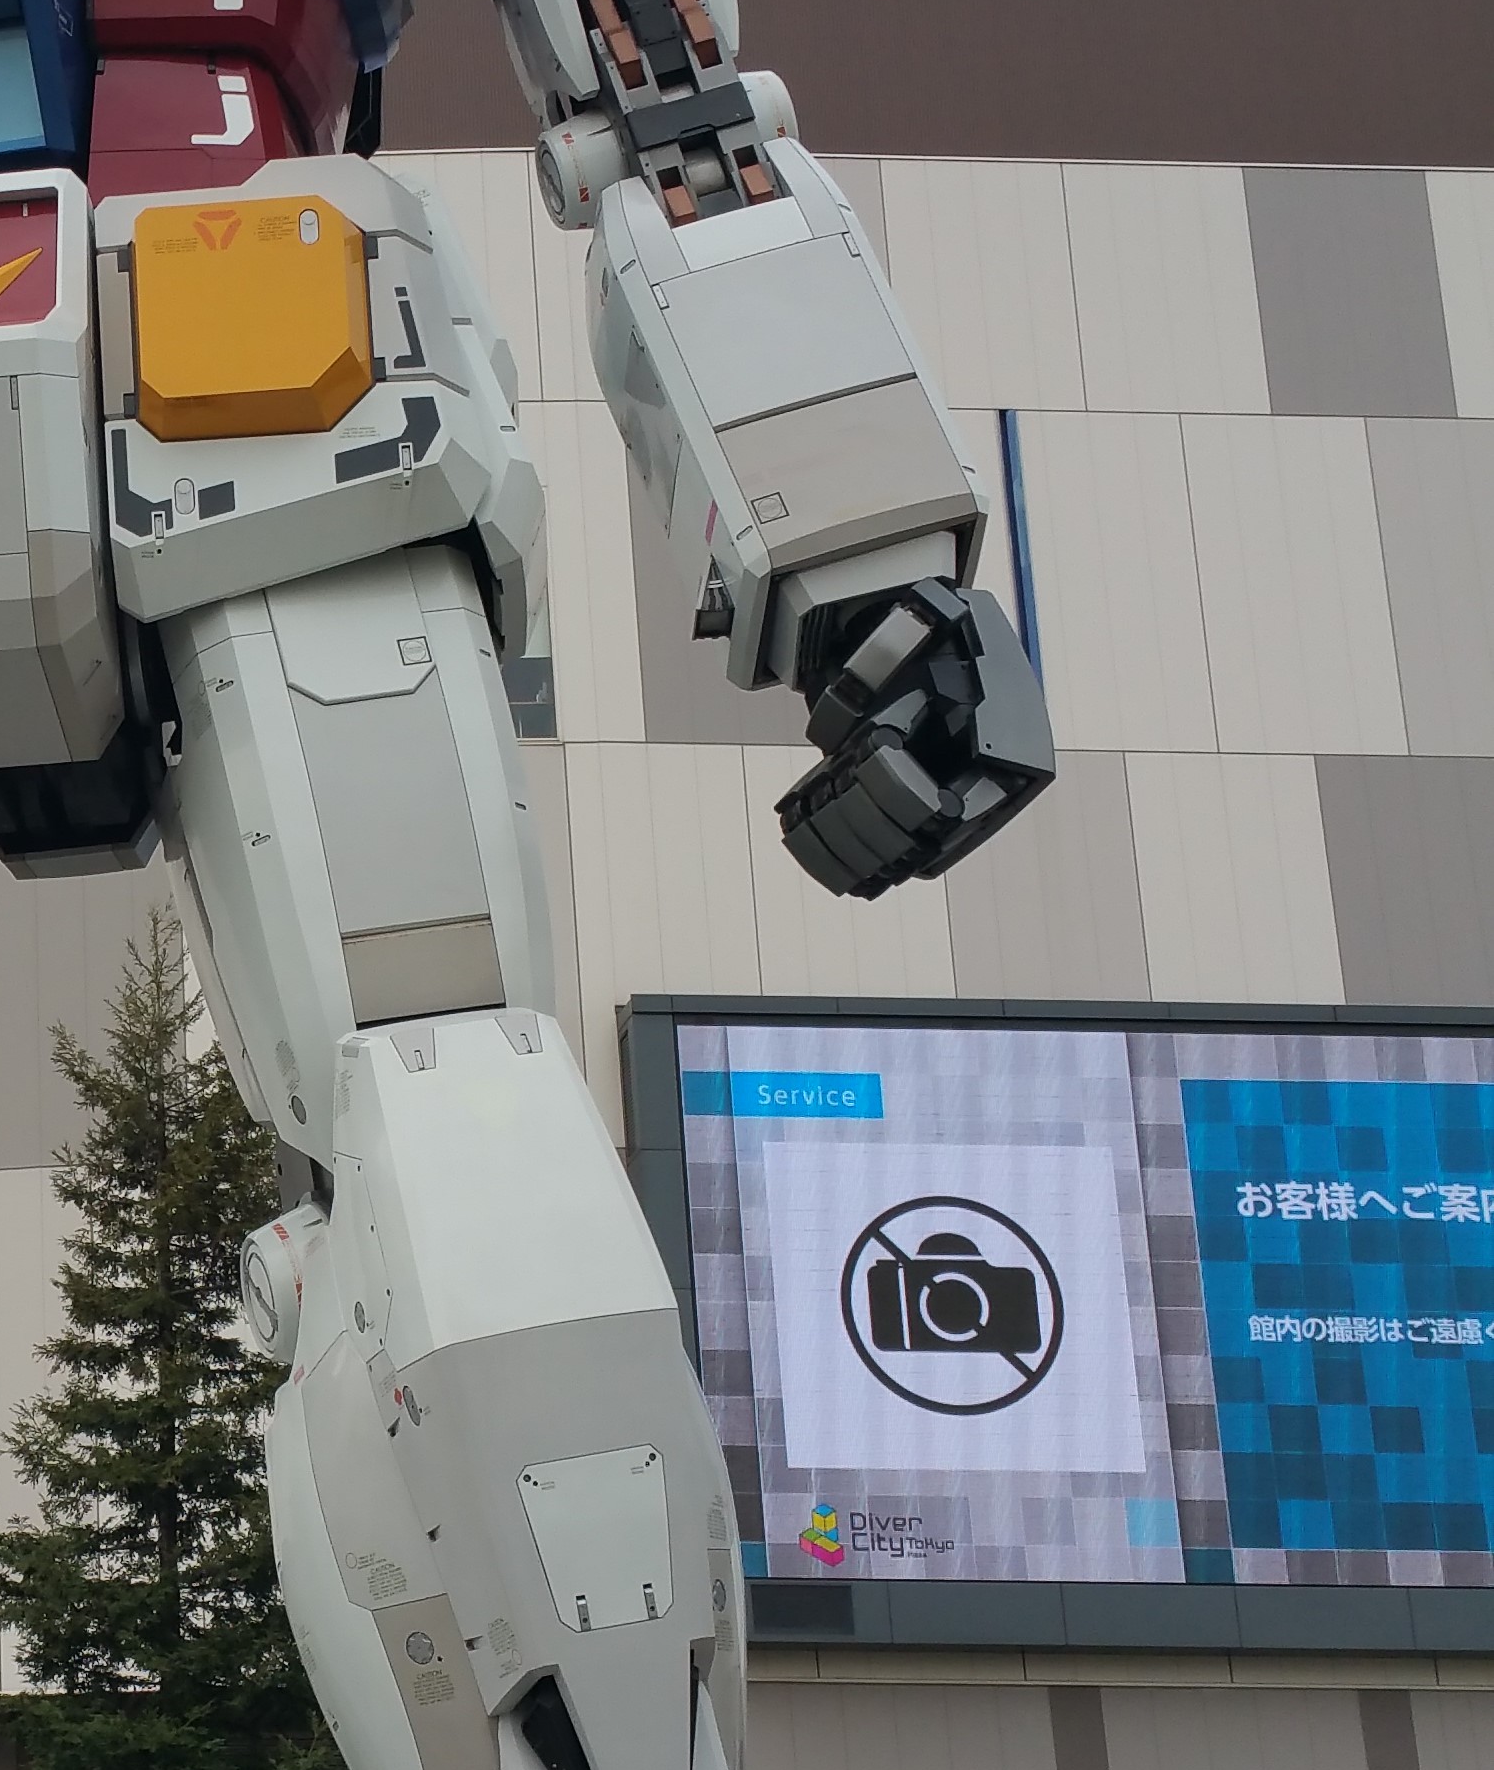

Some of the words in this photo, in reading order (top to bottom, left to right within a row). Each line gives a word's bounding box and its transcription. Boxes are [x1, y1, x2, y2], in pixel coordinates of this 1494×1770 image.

[757, 1084, 856, 1107] Service
[849, 1512, 923, 1532] Diver
[851, 1532, 904, 1558] City
